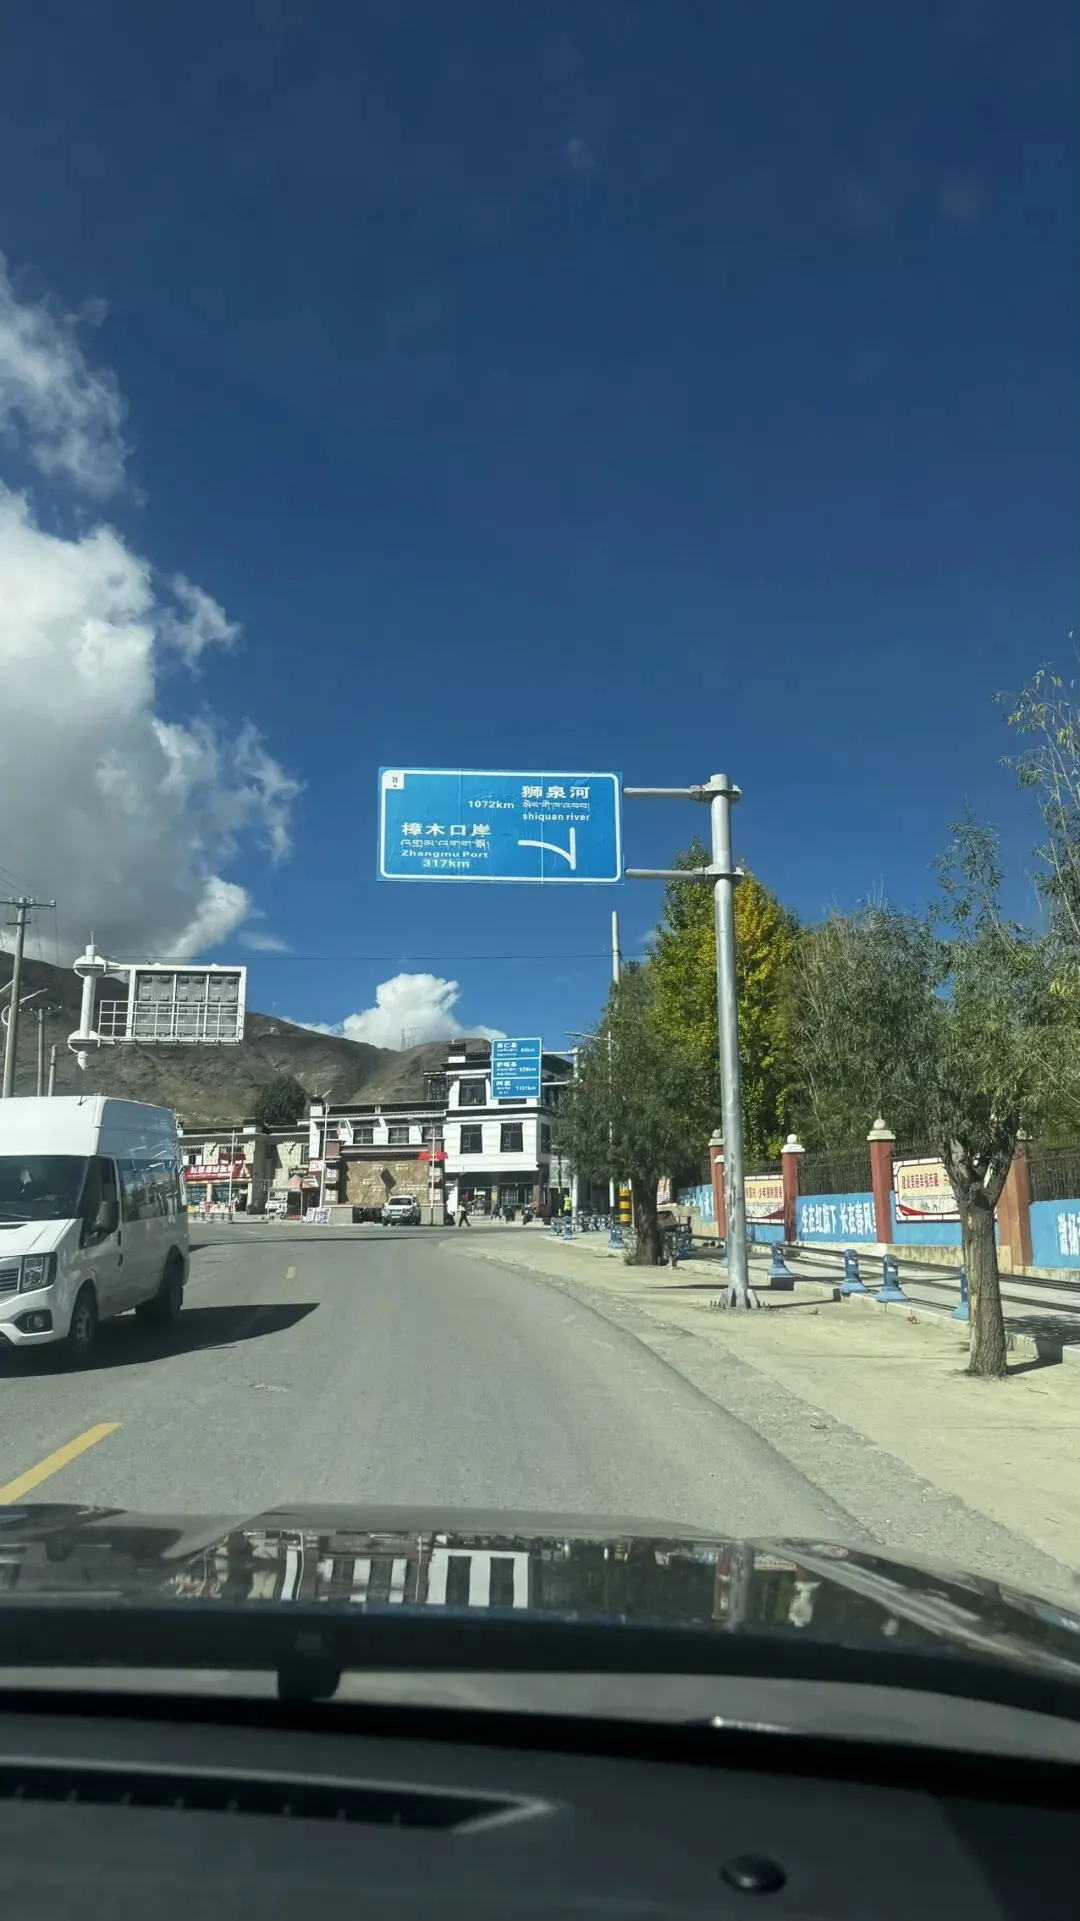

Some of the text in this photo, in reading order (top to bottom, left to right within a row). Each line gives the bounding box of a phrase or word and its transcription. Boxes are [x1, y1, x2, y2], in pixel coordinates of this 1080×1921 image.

[521, 785, 591, 799] 狮泉河
[468, 800, 515, 809] 1072km
[522, 812, 590, 822] shiquan river
[401, 822, 491, 837] 樟木口岸
[401, 850, 460, 858] Zhangmu
[423, 859, 470, 868] 317km
[801, 1203, 837, 1235] 生在红旗下
[1056, 1211, 1080, 1256] 激扬
